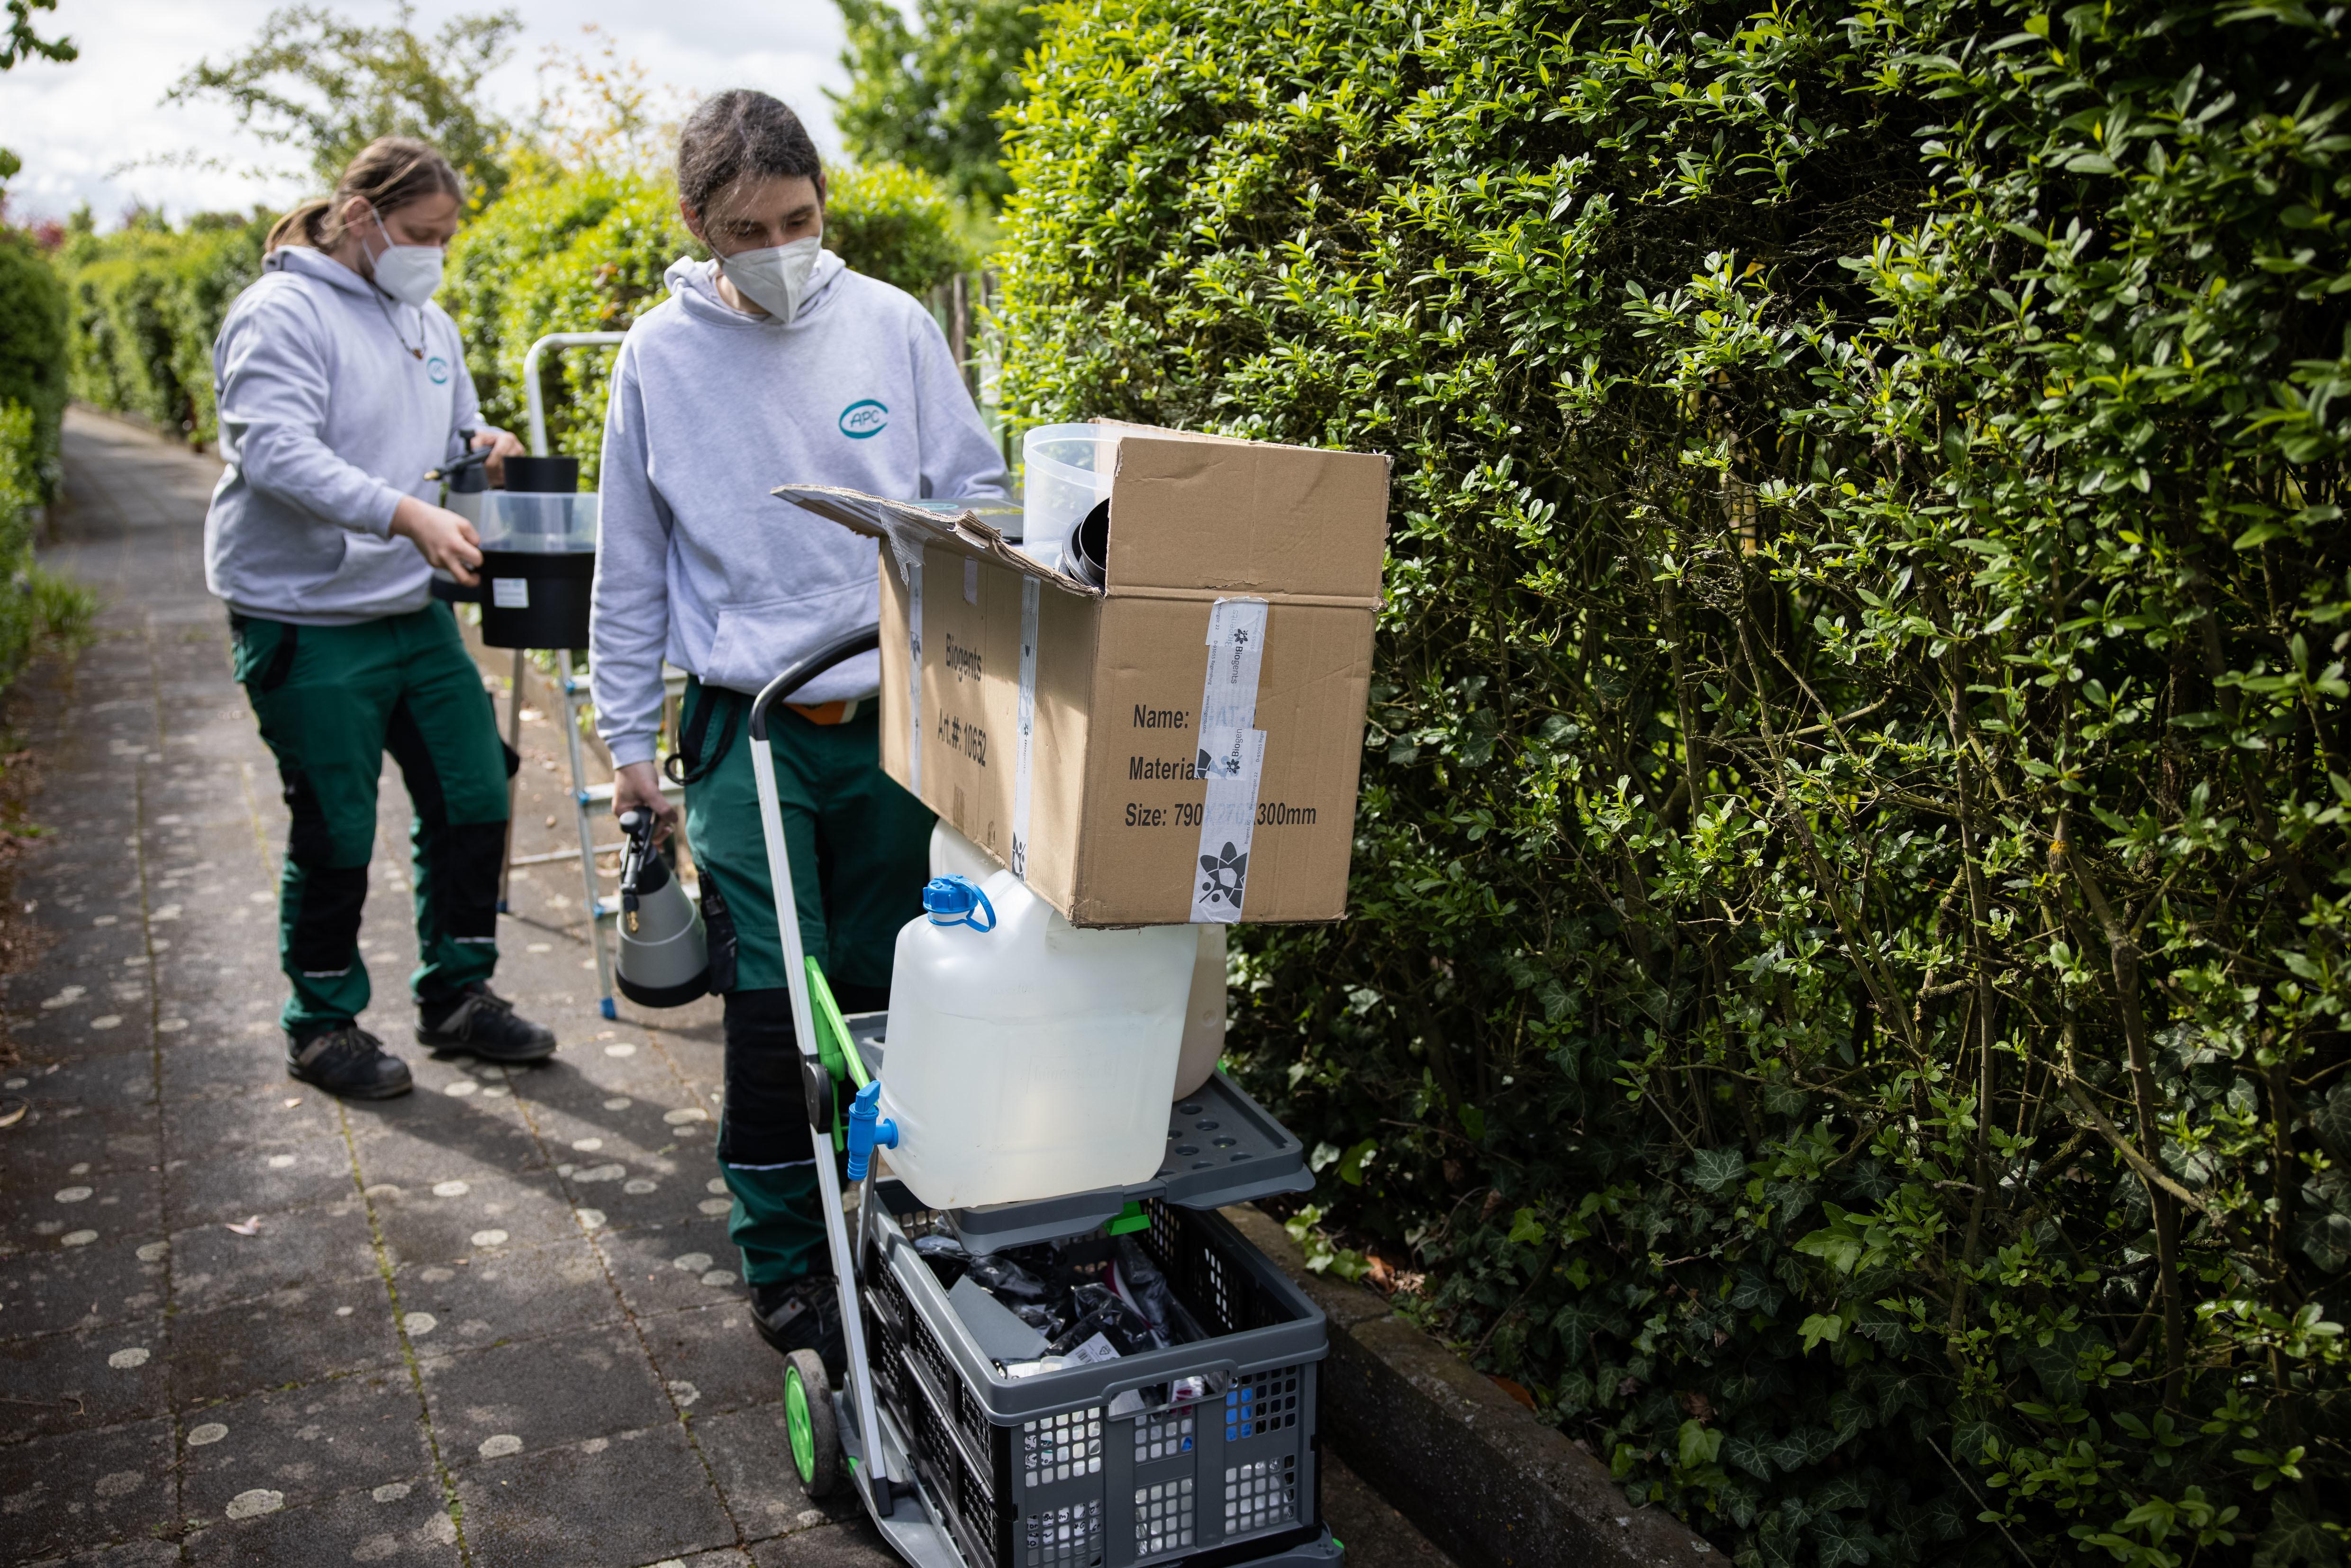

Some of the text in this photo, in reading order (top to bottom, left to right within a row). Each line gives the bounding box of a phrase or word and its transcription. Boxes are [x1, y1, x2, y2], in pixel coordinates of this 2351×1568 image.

[850, 409, 879, 427] APC
[946, 633, 981, 682] Biogents
[1231, 646, 1243, 684] Biogents
[1133, 704, 1189, 729] Name:
[964, 722, 986, 767] 10652
[1232, 728, 1243, 757] Biogen
[1125, 803, 1166, 827] Size:
